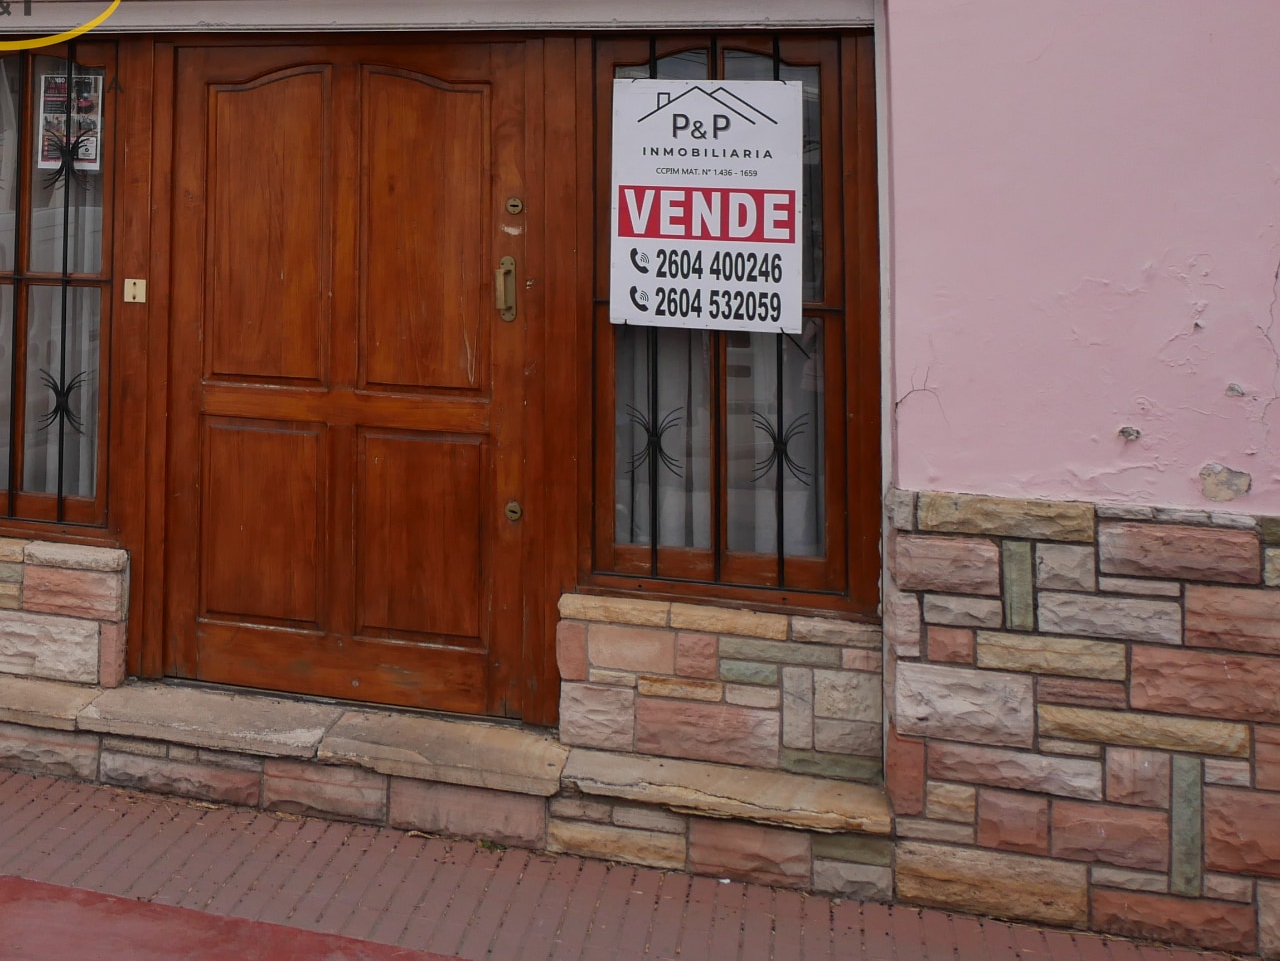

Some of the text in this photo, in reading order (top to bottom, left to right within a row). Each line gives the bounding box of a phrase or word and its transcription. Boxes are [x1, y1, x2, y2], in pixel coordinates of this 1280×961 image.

[672, 113, 732, 140] P&P
[642, 146, 774, 159] INMOBILIARIA
[656, 167, 680, 175] CCPIM
[681, 168, 700, 176] MAT.
[740, 169, 758, 177] 1659
[624, 188, 790, 240] VENDE
[655, 248, 782, 284] 2604 400246
[655, 286, 781, 323] 2604 532059
